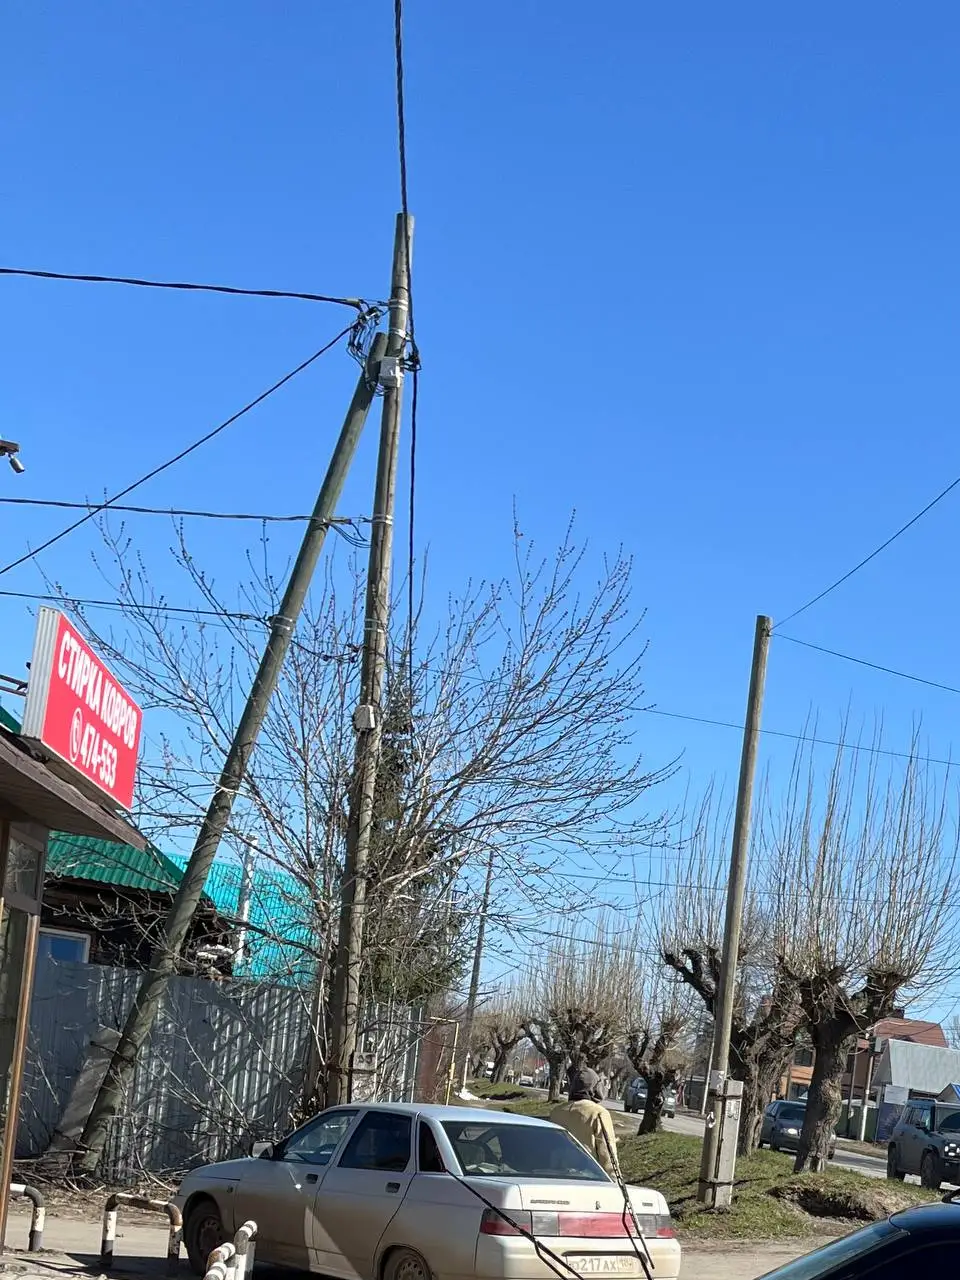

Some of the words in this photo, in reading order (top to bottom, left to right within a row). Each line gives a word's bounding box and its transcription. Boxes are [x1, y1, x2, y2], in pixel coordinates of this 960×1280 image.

[58, 630, 102, 716] СТИРКА
[100, 679, 137, 749] КОВРОВ
[80, 722, 117, 789] 474-553
